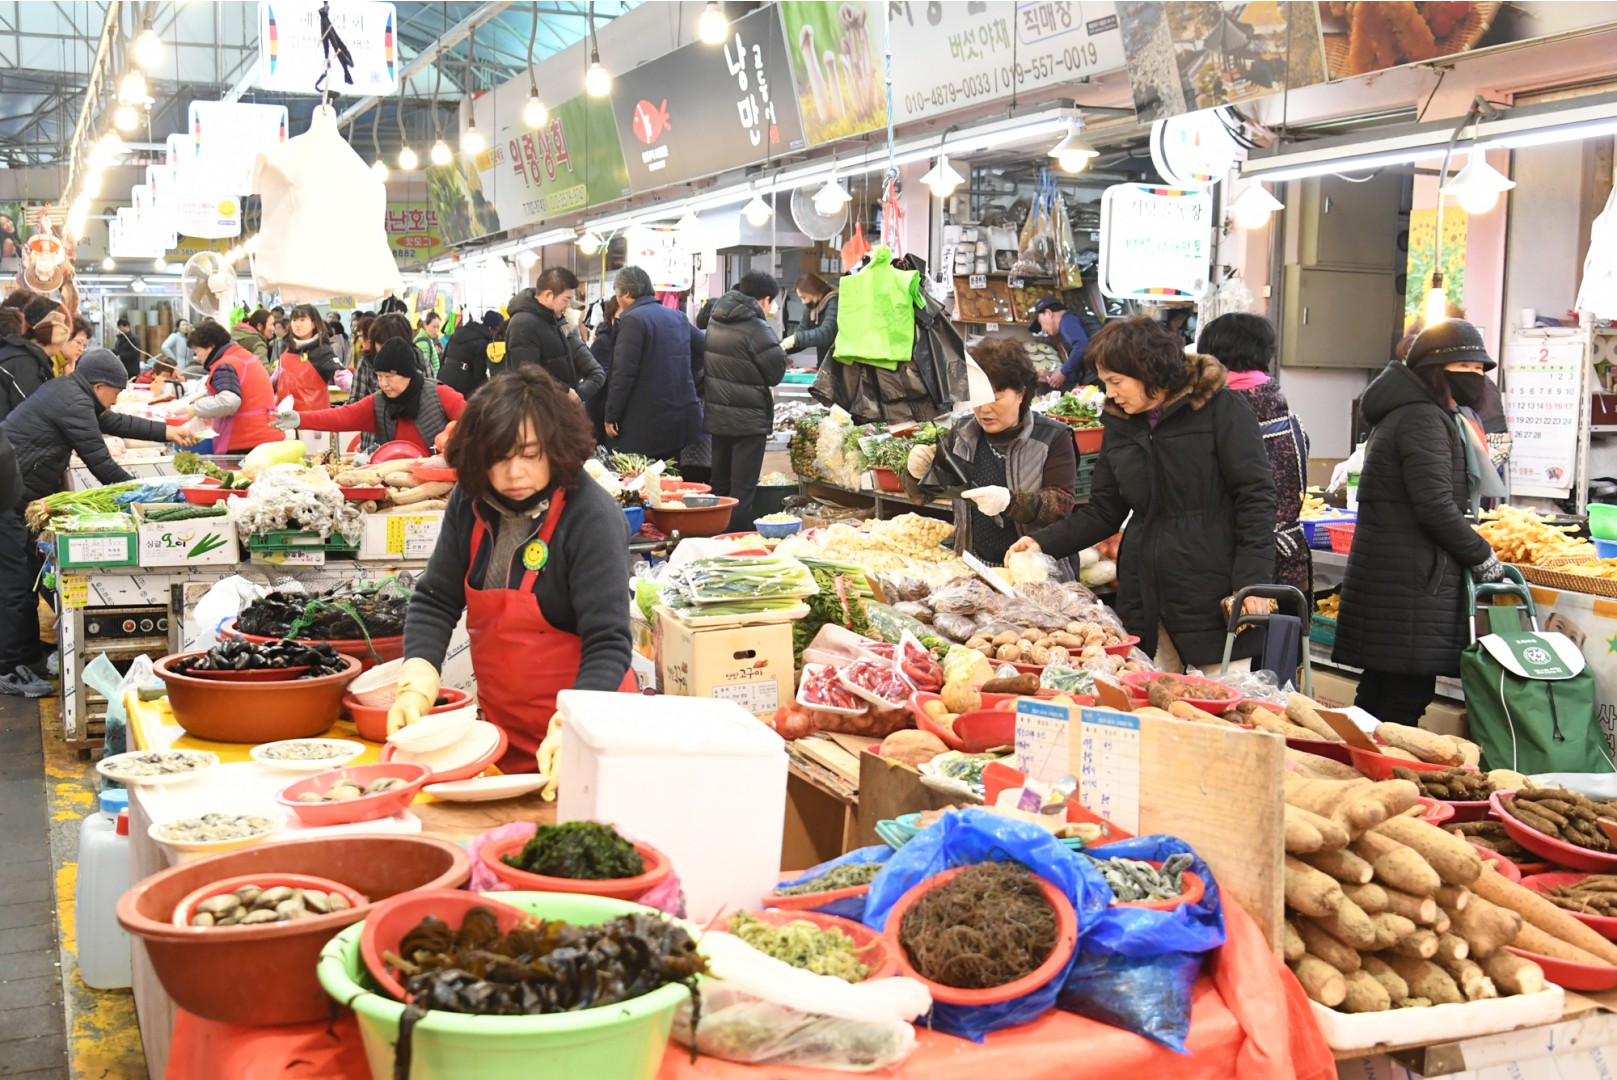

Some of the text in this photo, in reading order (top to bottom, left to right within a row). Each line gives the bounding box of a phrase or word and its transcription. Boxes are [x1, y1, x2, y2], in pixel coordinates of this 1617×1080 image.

[1023, 1, 1072, 36] 직매장
[948, 17, 1011, 63] 버섯,야채
[724, 32, 761, 147] 낭만
[904, 73, 991, 114] 010-4879-0033
[1001, 42, 1098, 88] 019-557-0019
[508, 117, 574, 188] 의령상회
[1539, 348, 1549, 363] 2
[1533, 431, 1542, 439] 28
[146, 532, 186, 548] 싱글 오이
[739, 667, 764, 680] 고구마
